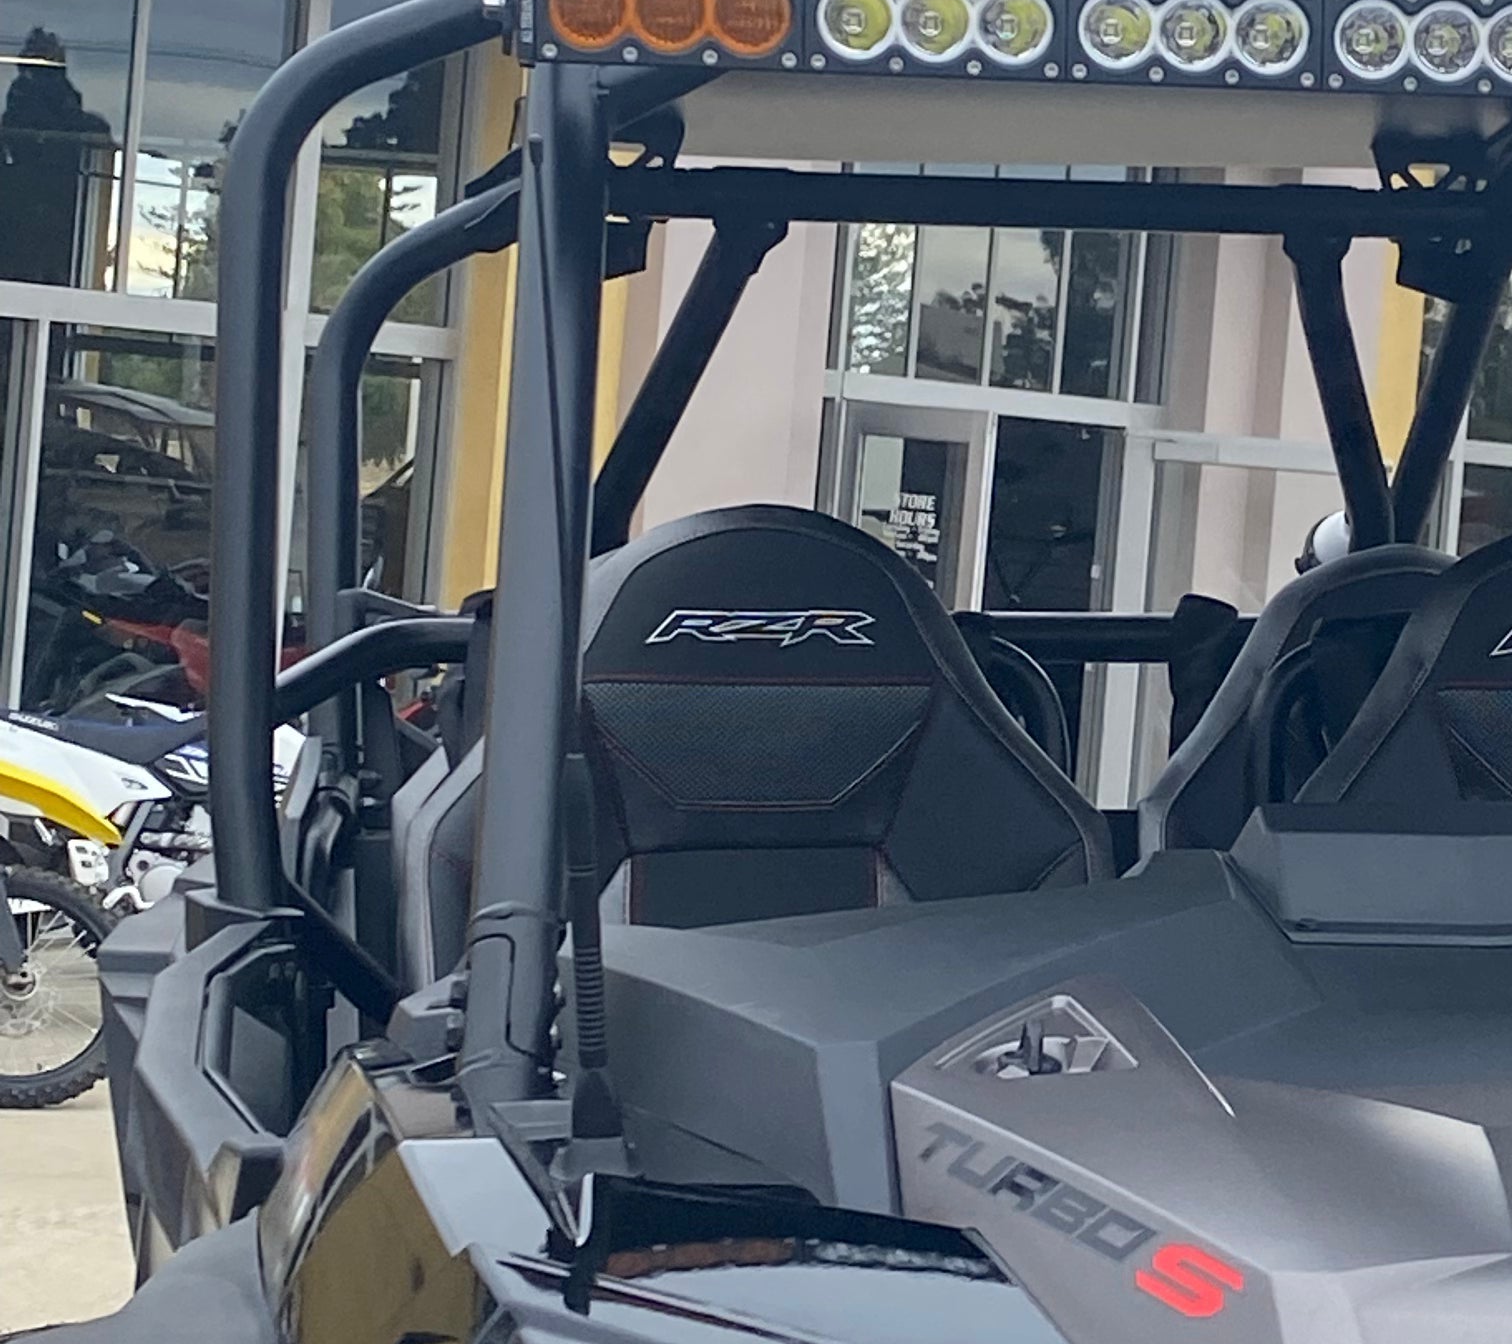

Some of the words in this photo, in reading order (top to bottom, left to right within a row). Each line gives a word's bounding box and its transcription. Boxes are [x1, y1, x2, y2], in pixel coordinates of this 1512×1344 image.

[645, 609, 876, 647] RZR
[918, 1122, 1157, 1262] TURBO
[1135, 1242, 1244, 1318] S
